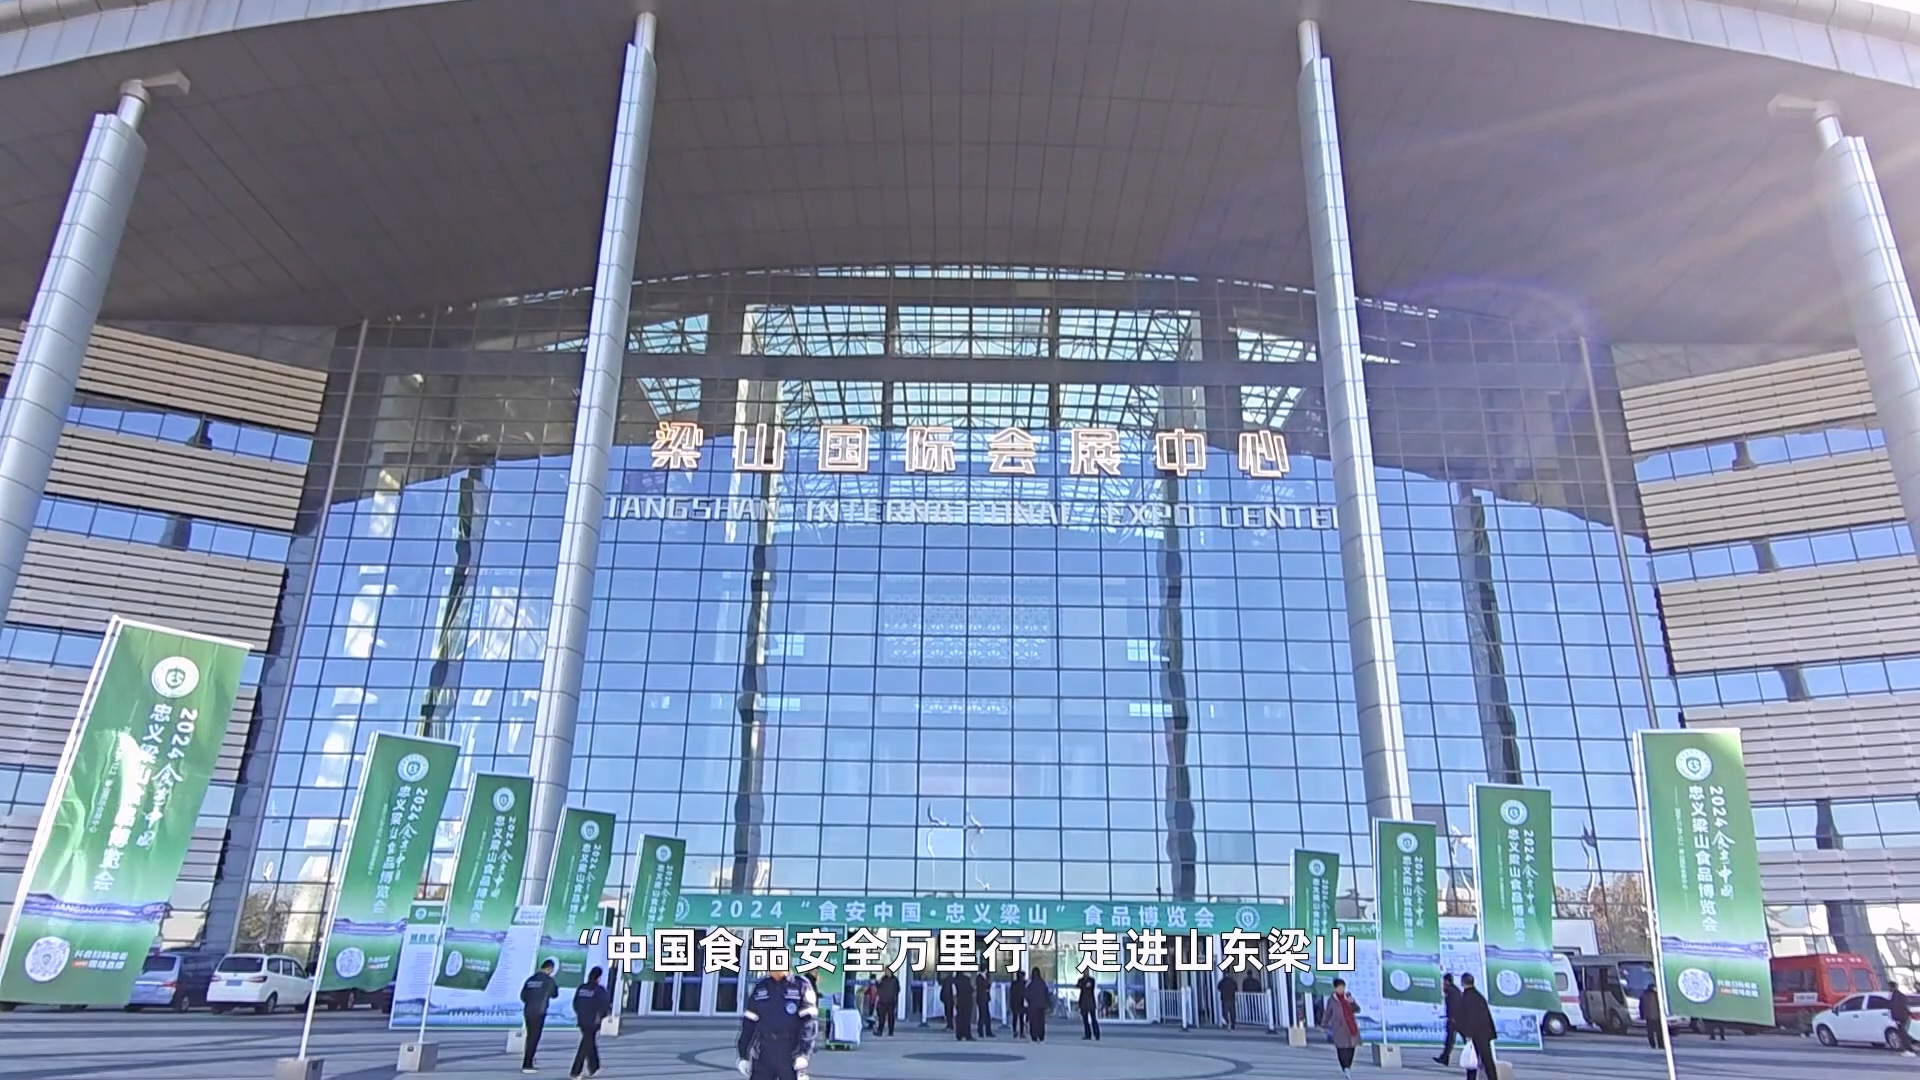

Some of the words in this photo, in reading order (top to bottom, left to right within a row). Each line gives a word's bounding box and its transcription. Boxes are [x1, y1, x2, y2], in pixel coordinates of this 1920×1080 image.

[651, 421, 1291, 478] 梁山国际会展中心
[608, 495, 779, 520] IANGSHAN
[806, 498, 1071, 525] INTERNATIONAL
[1105, 502, 1196, 527] EXPO
[1688, 784, 1719, 932] 忠义梁山食品博览会
[709, 899, 784, 919] 2024
[1083, 905, 1217, 929] 食品博览会
